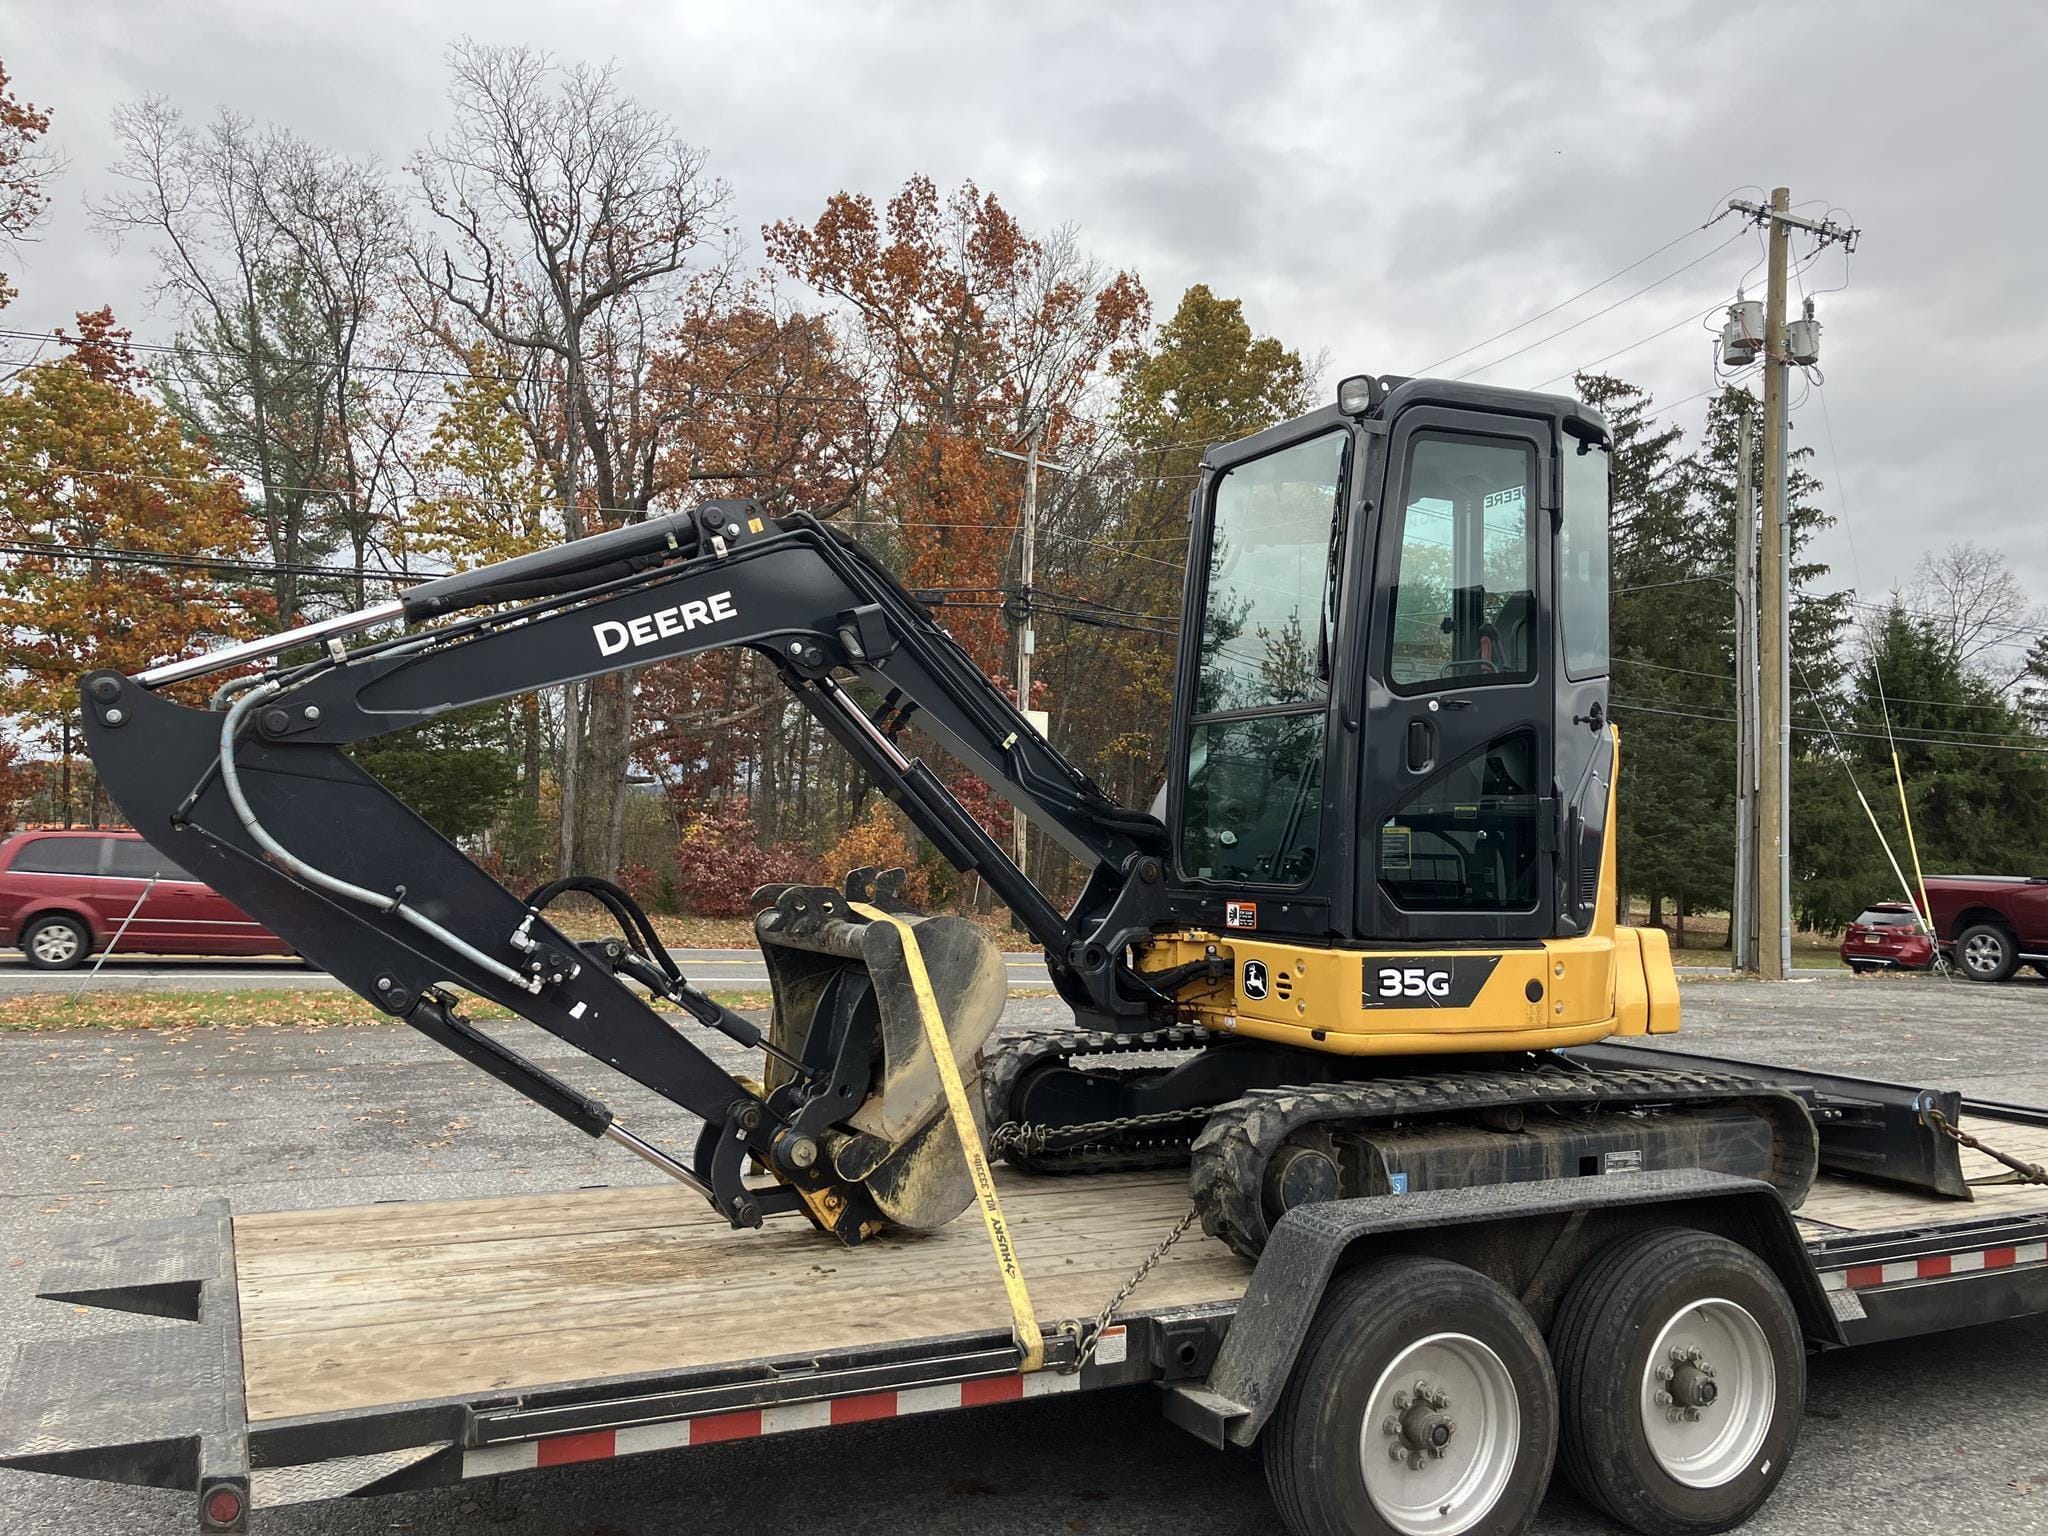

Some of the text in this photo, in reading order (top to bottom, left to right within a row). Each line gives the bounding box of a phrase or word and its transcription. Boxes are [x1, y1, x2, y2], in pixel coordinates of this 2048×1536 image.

[592, 591, 738, 657] DEERE
[1379, 969, 1450, 997] 35G
[973, 1152, 1013, 1263] HUSKY WLL 3333lbs
